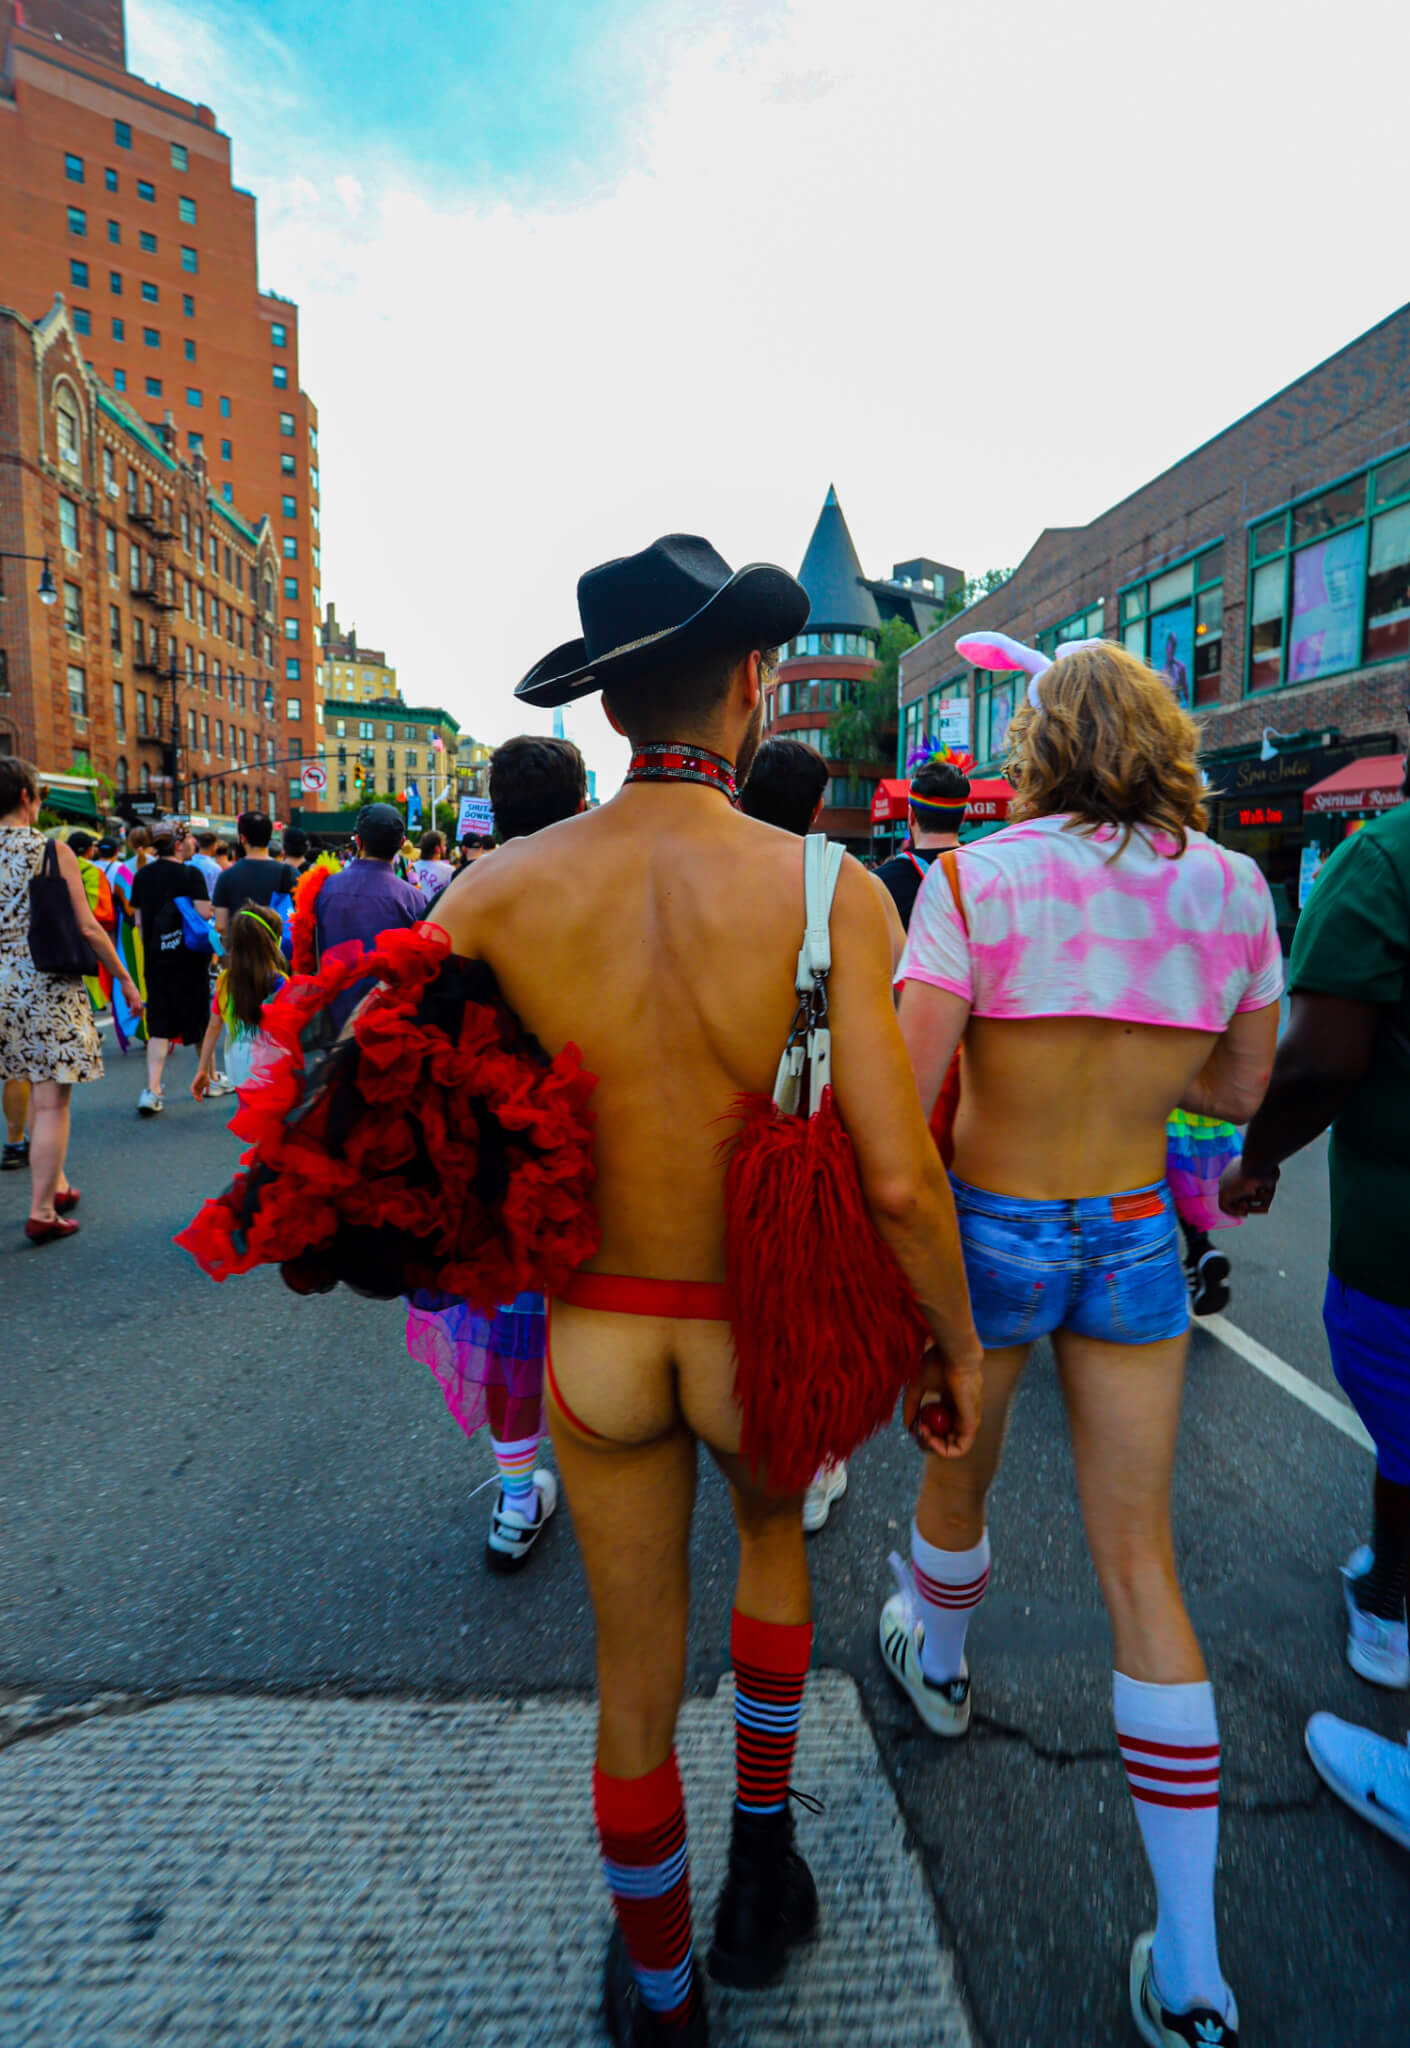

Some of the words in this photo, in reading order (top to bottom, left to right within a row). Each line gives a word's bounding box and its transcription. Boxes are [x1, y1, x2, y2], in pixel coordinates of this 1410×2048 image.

[1235, 761, 1267, 788] Spa
[467, 803, 489, 812] SHUT
[1312, 790, 1366, 811] Spiritual
